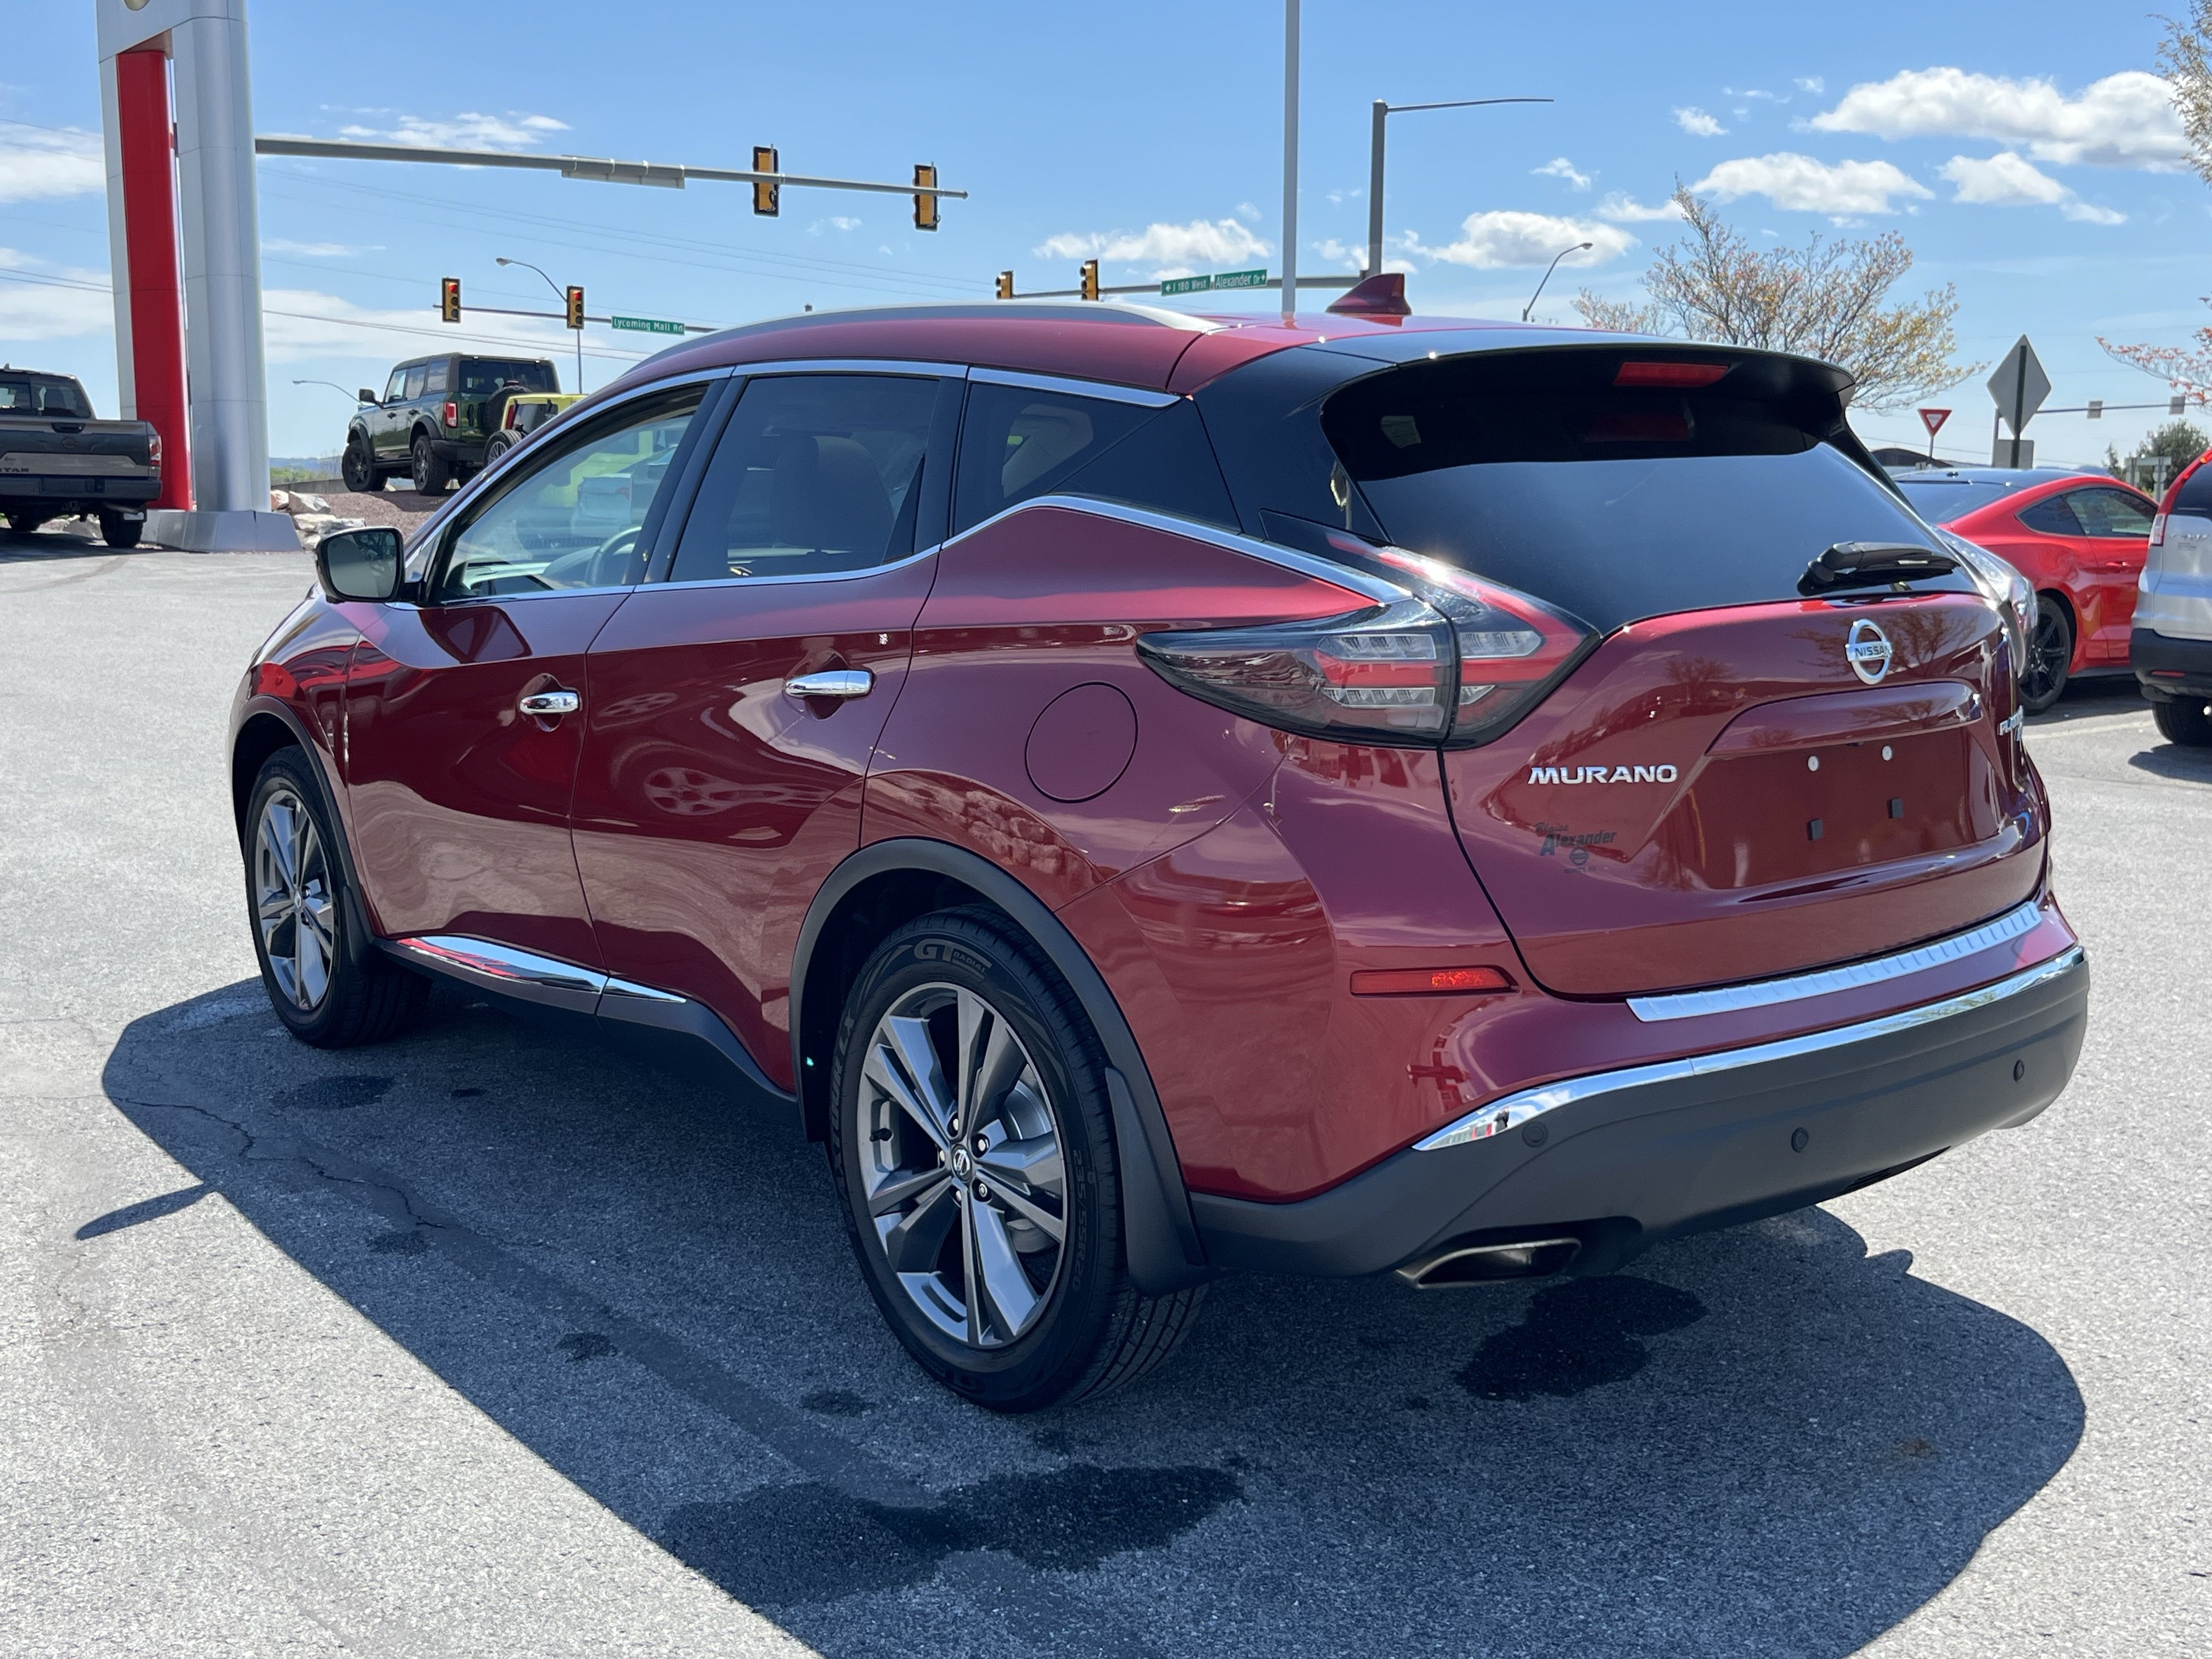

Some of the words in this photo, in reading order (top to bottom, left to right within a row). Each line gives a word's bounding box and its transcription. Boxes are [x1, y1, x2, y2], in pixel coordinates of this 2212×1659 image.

[1178, 281, 1189, 291] 180
[1192, 279, 1207, 290] West
[1216, 274, 1252, 288] Alexander
[1254, 275, 1261, 285] Dr
[613, 318, 651, 331] Lycoming
[653, 321, 670, 331] Mall
[673, 324, 683, 332] Rd
[1854, 645, 1890, 657] NISSAN
[1528, 764, 1678, 785] MURANO
[1540, 829, 1618, 856] Alexander
[914, 938, 992, 969] GT
[953, 951, 987, 973] RADIAL
[1072, 1149, 1088, 1290] 235/55R20
